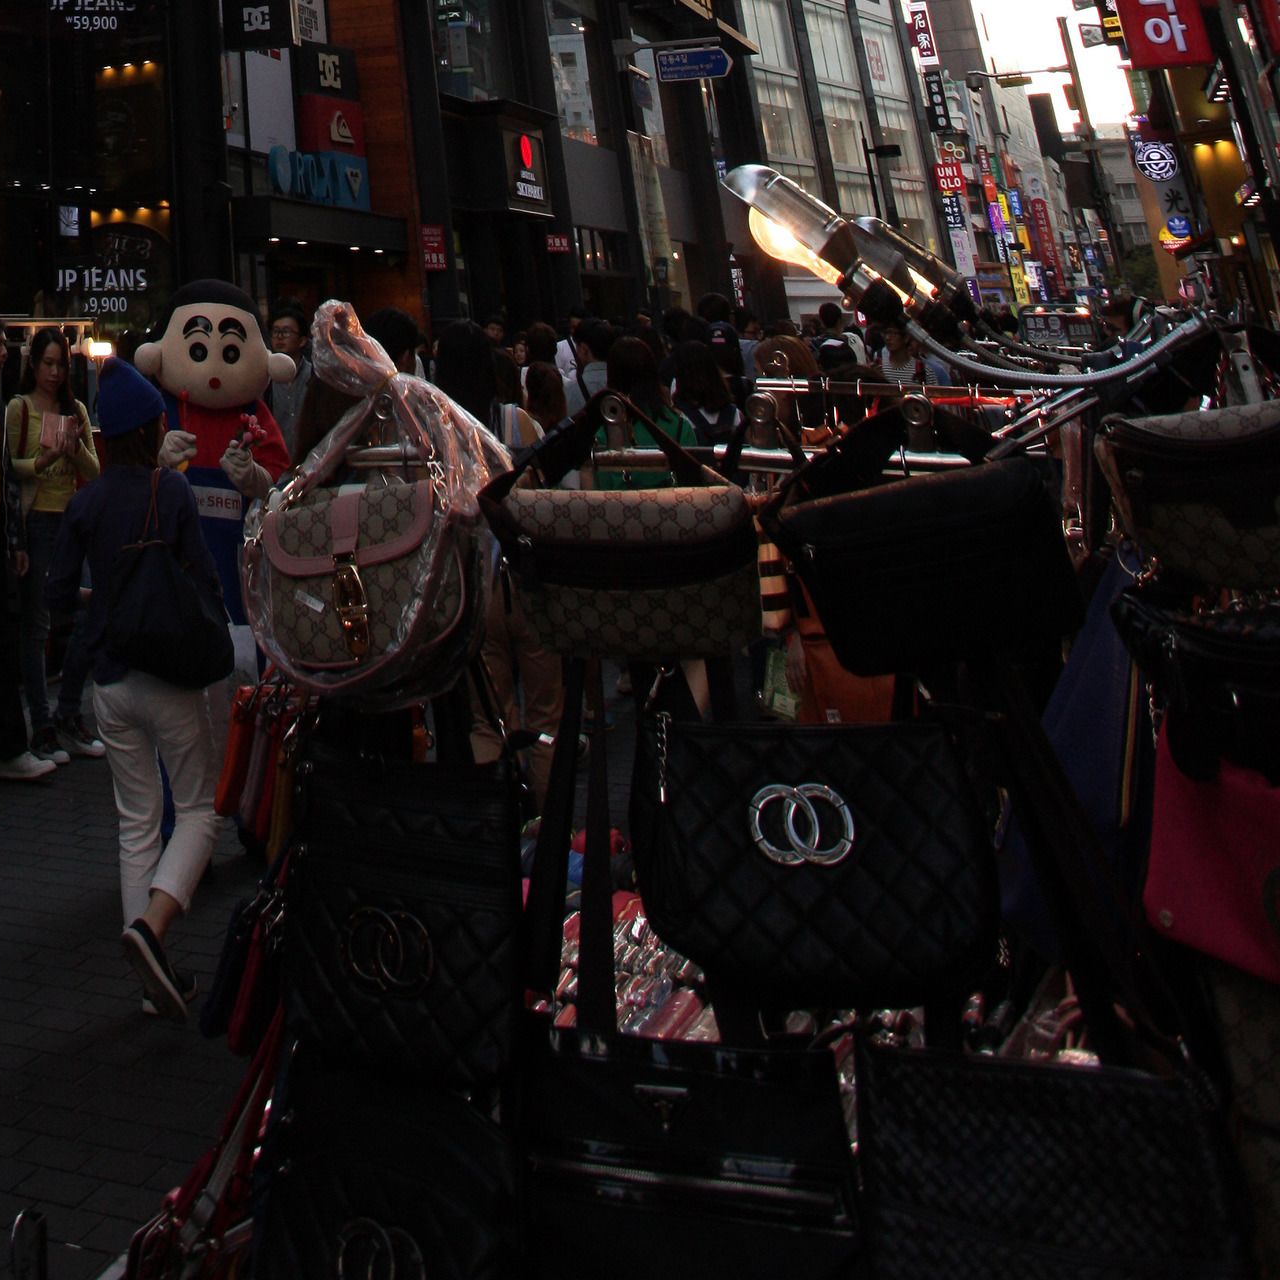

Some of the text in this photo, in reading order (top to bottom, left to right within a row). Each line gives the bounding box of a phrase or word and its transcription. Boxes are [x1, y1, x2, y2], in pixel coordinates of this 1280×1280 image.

[936, 165, 958, 178] UNI
[939, 176, 962, 191] QLO
[56, 268, 80, 292] JP
[83, 296, 129, 314] 9,900
[207, 495, 241, 511] SAEM
